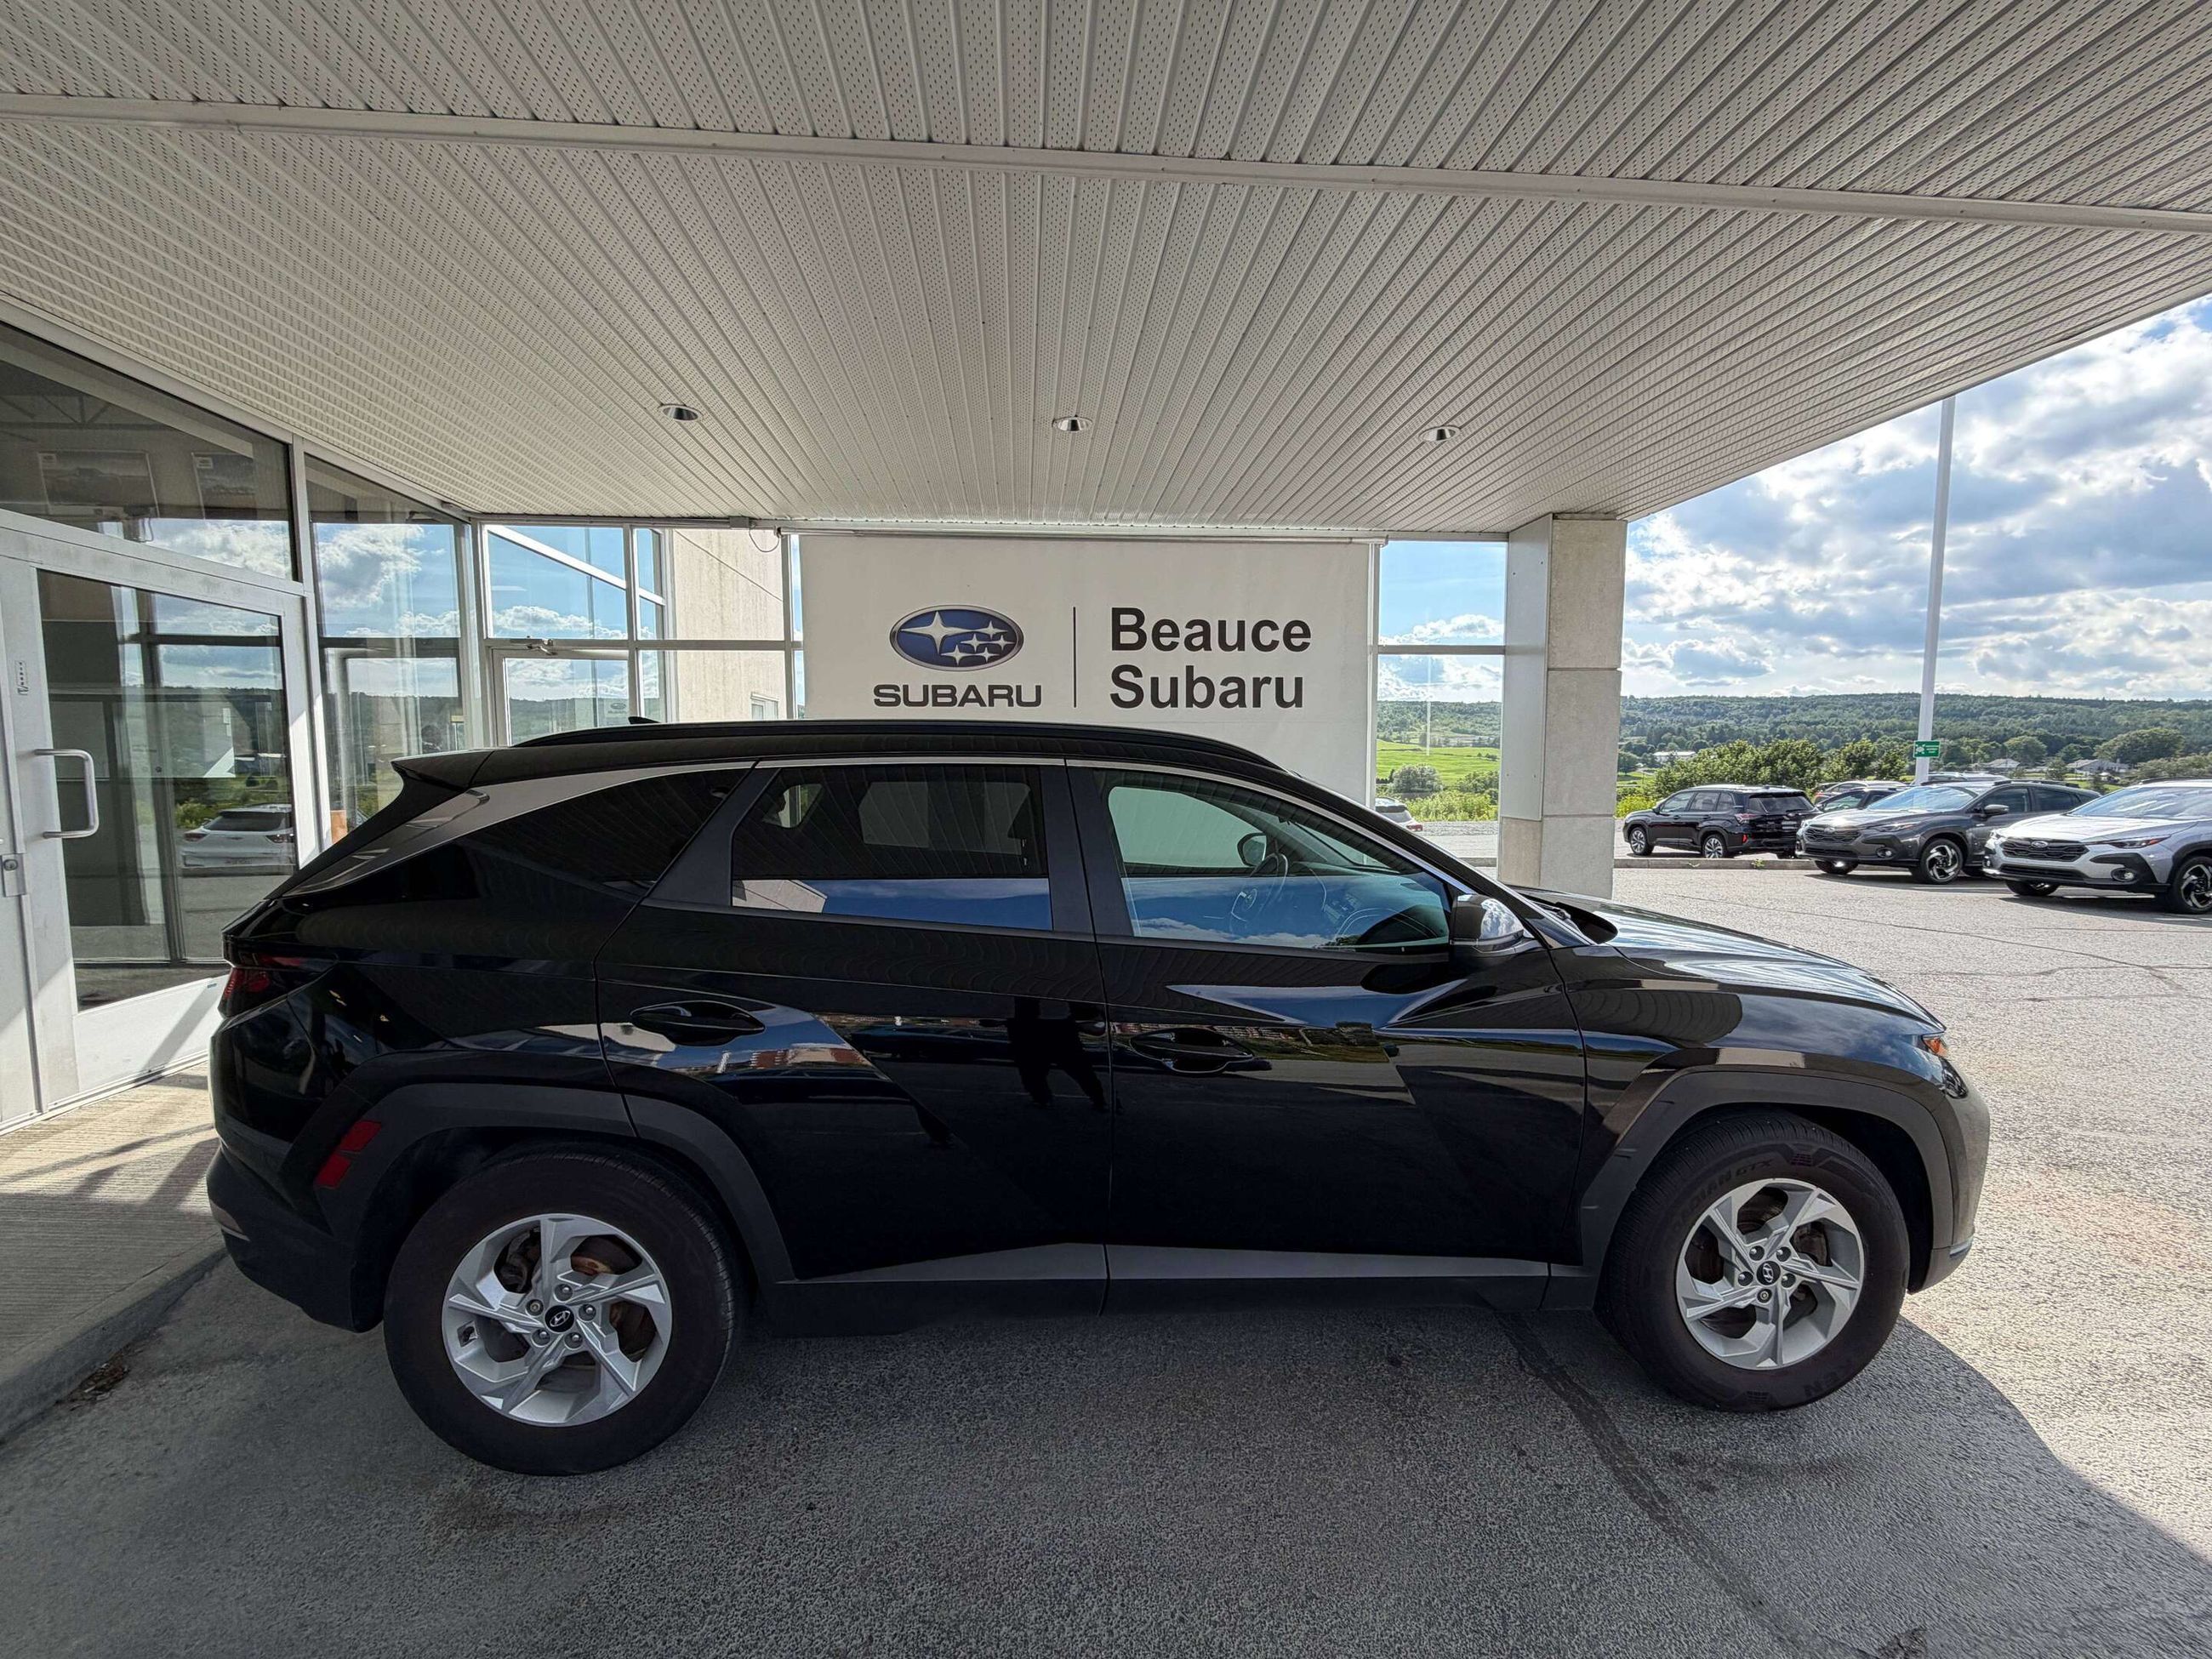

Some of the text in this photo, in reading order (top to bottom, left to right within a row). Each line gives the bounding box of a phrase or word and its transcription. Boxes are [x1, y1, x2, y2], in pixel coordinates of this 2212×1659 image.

[1111, 607, 1311, 653] Beauce
[873, 684, 1042, 708] SUBARU
[1109, 664, 1303, 709] Subaru
